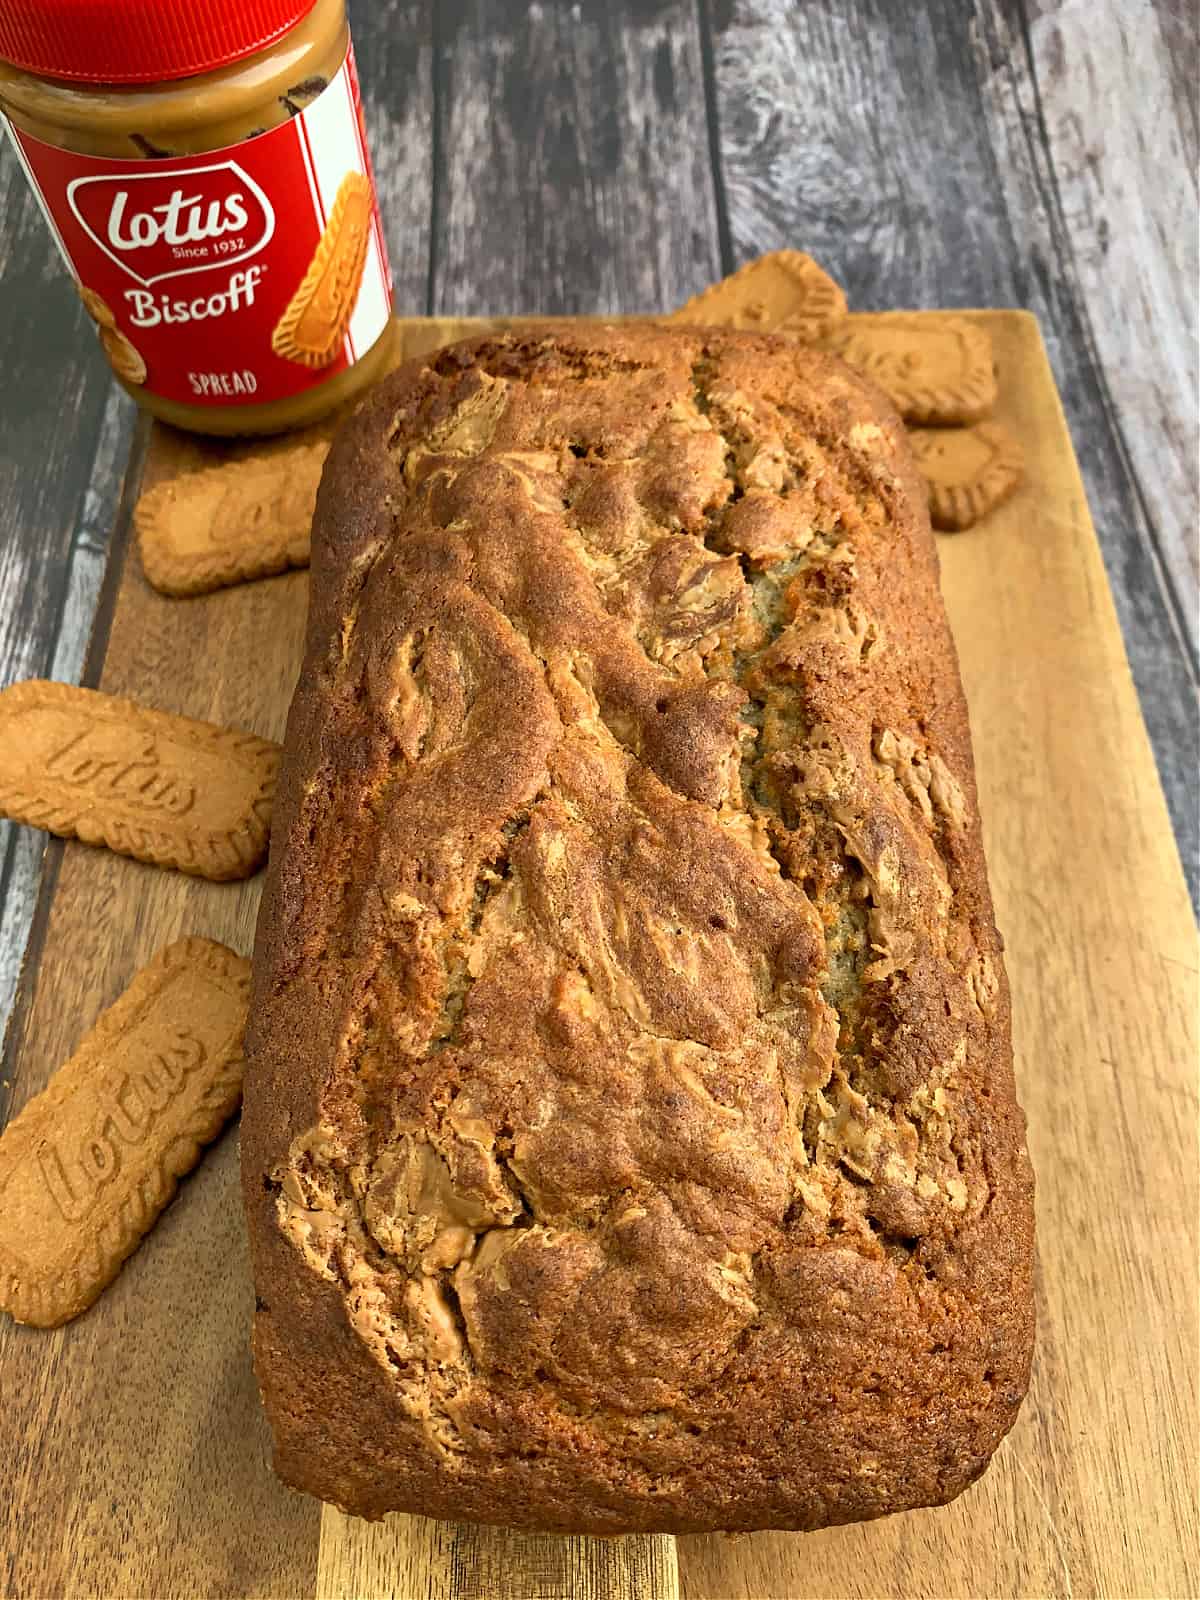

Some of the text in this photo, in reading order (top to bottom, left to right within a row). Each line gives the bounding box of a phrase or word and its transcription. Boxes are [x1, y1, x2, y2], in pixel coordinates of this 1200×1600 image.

[172, 239, 246, 259] Since 1932
[124, 265, 262, 327] Biscoff
[189, 371, 257, 396] SPREAD
